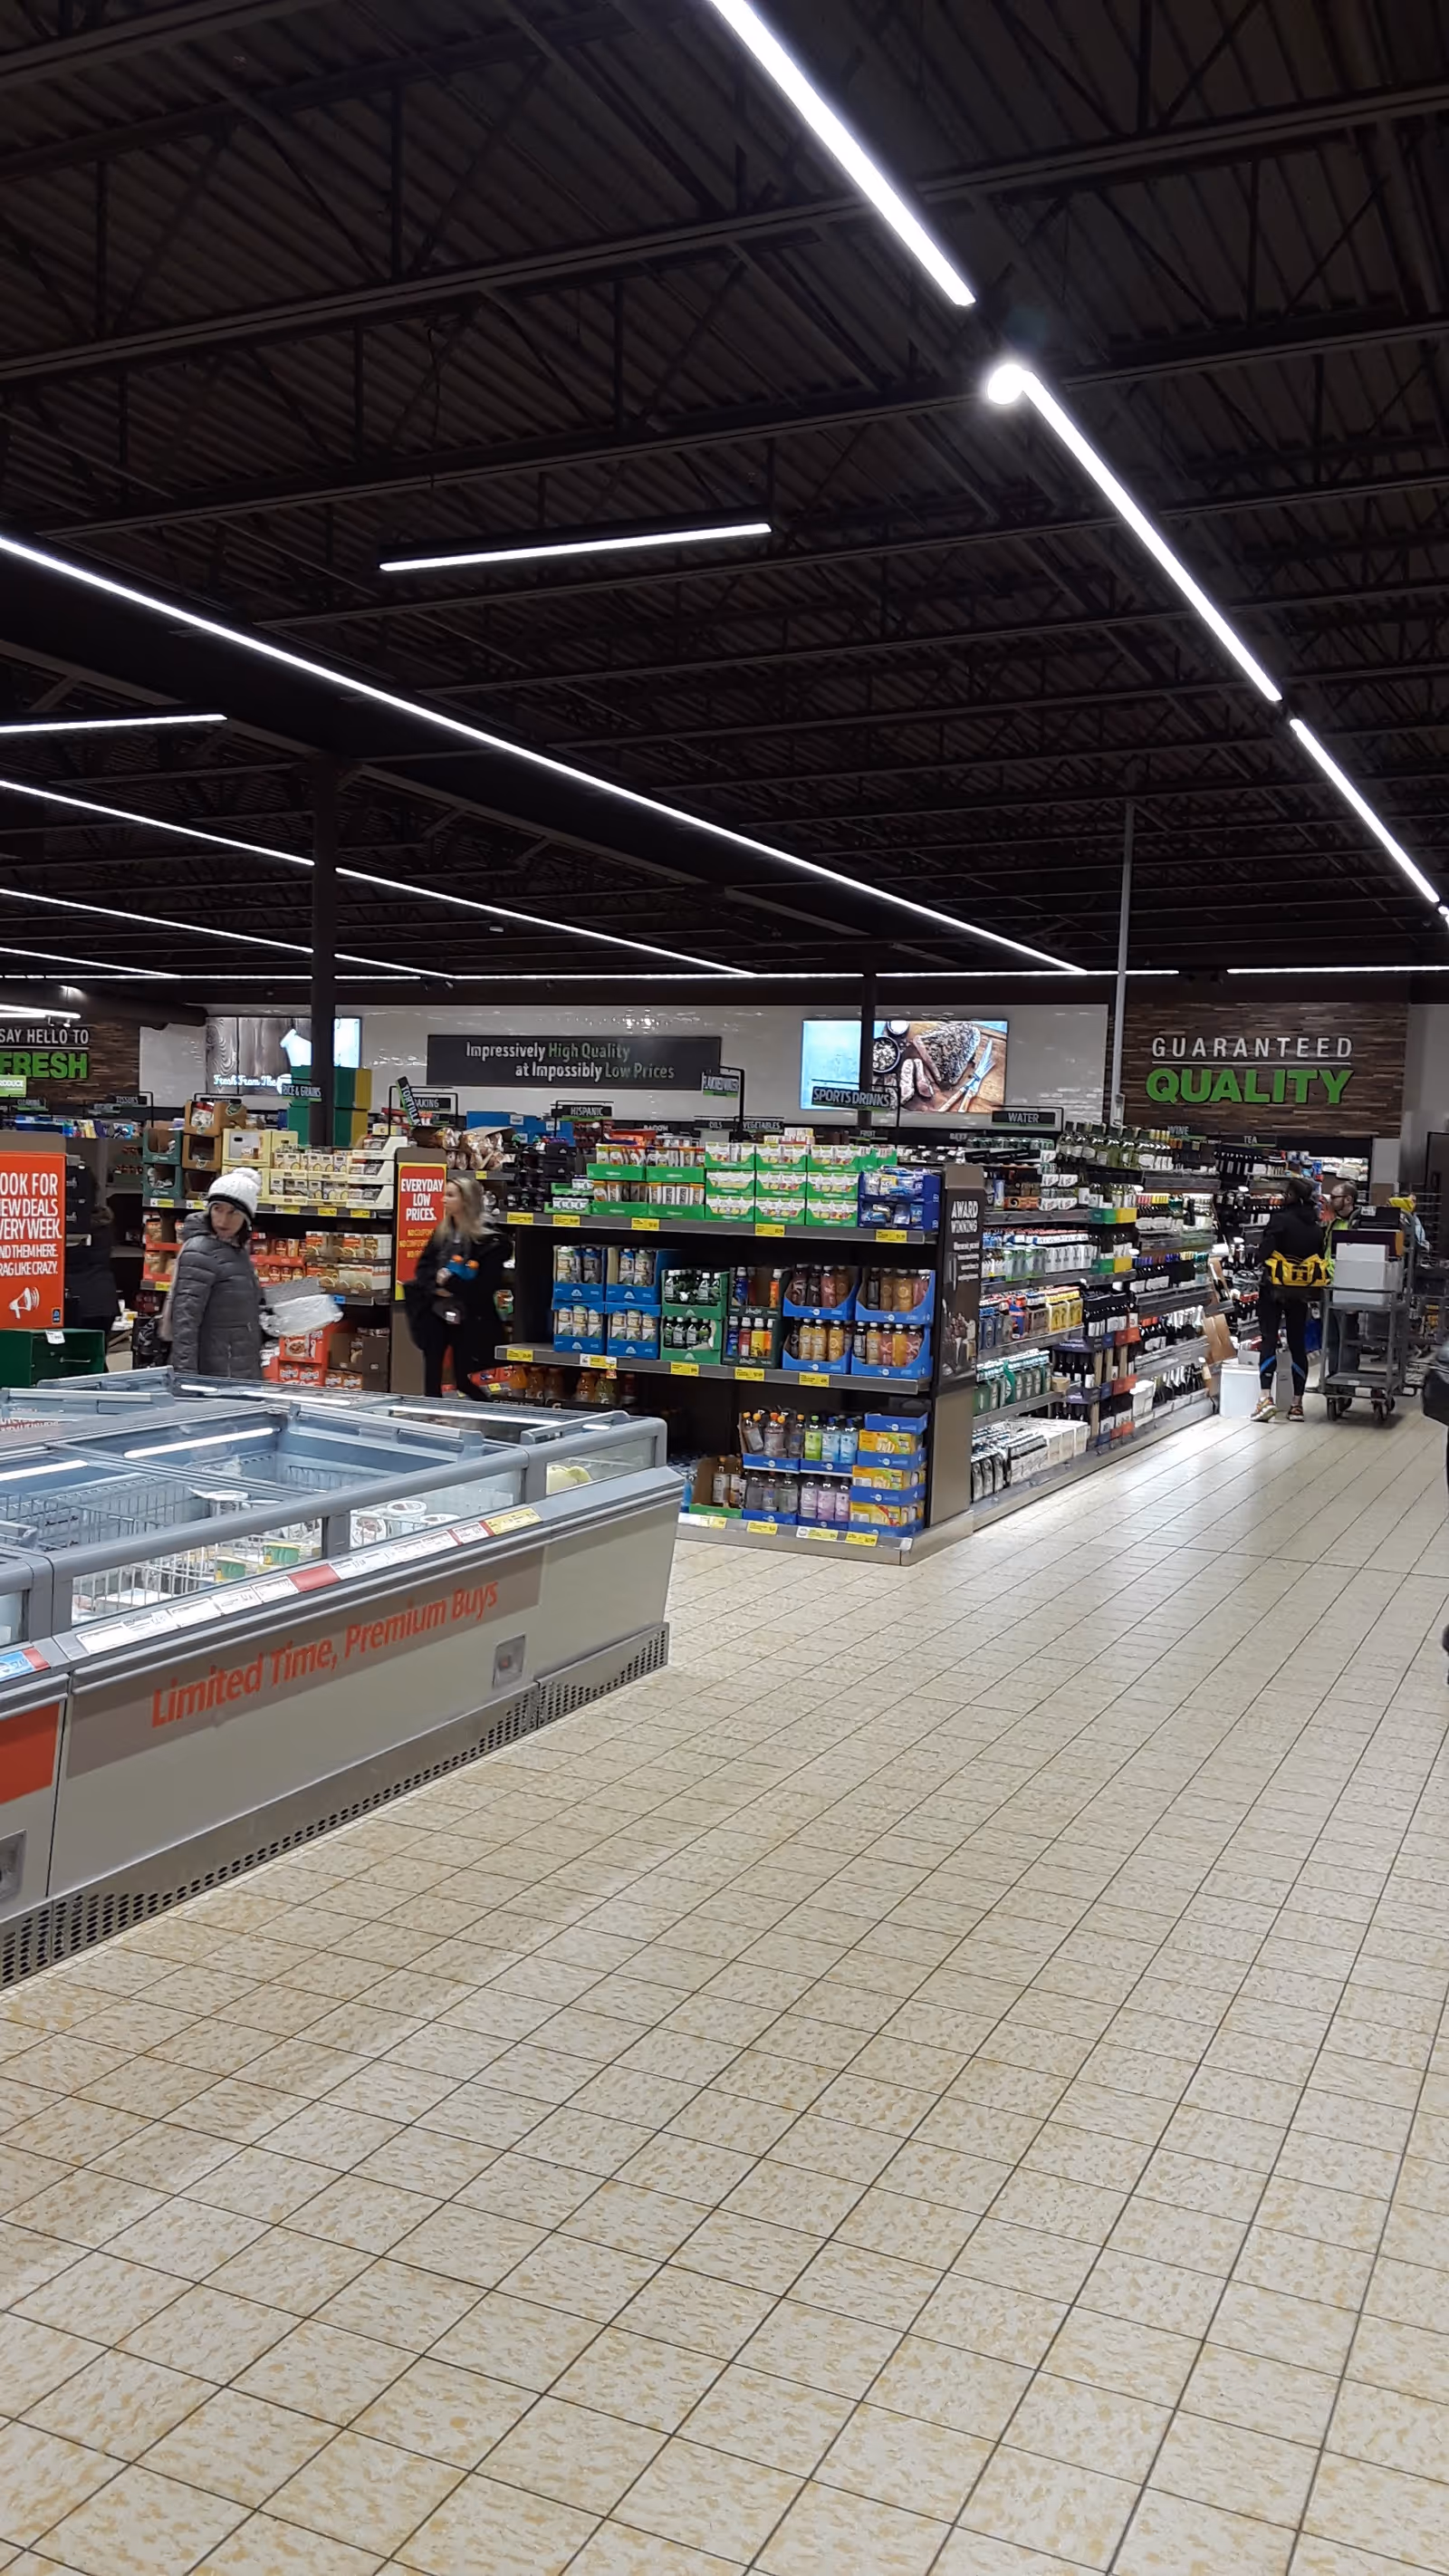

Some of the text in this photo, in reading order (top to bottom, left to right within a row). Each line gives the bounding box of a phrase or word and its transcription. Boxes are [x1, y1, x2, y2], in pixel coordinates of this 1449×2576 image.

[0, 1029, 89, 1044] SAY HELLO TO
[466, 1042, 630, 1062] Impressively High Quality
[1152, 1037, 1352, 1058] GUARANTEED
[0, 1052, 88, 1079] FRESH
[515, 1062, 675, 1082] at Impossibly Low Prices
[214, 1074, 237, 1086] Fresh
[1146, 1068, 1353, 1104] QUALITY
[414, 1098, 439, 1108] AKING
[813, 1088, 889, 1107] SPORTS DRINKS
[571, 1107, 604, 1116] HISPANIC
[1008, 1112, 1040, 1123] WATER
[743, 1120, 780, 1129] VEGETABLES
[1243, 1135, 1257, 1144] TEA
[0, 1172, 58, 1196] OOK FOR
[401, 1178, 444, 1192] EVERYDAY
[0, 1198, 58, 1217] EW DEALS
[413, 1193, 431, 1206] LOW
[406, 1207, 437, 1221] PRICES.
[951, 1200, 978, 1218] AWARD
[0, 1218, 62, 1239] VERY WEEK.
[14, 1262, 33, 1275] LIKE
[33, 1260, 58, 1275] CRAZY.
[152, 1581, 499, 1728] Limited Time, Premium Buys
